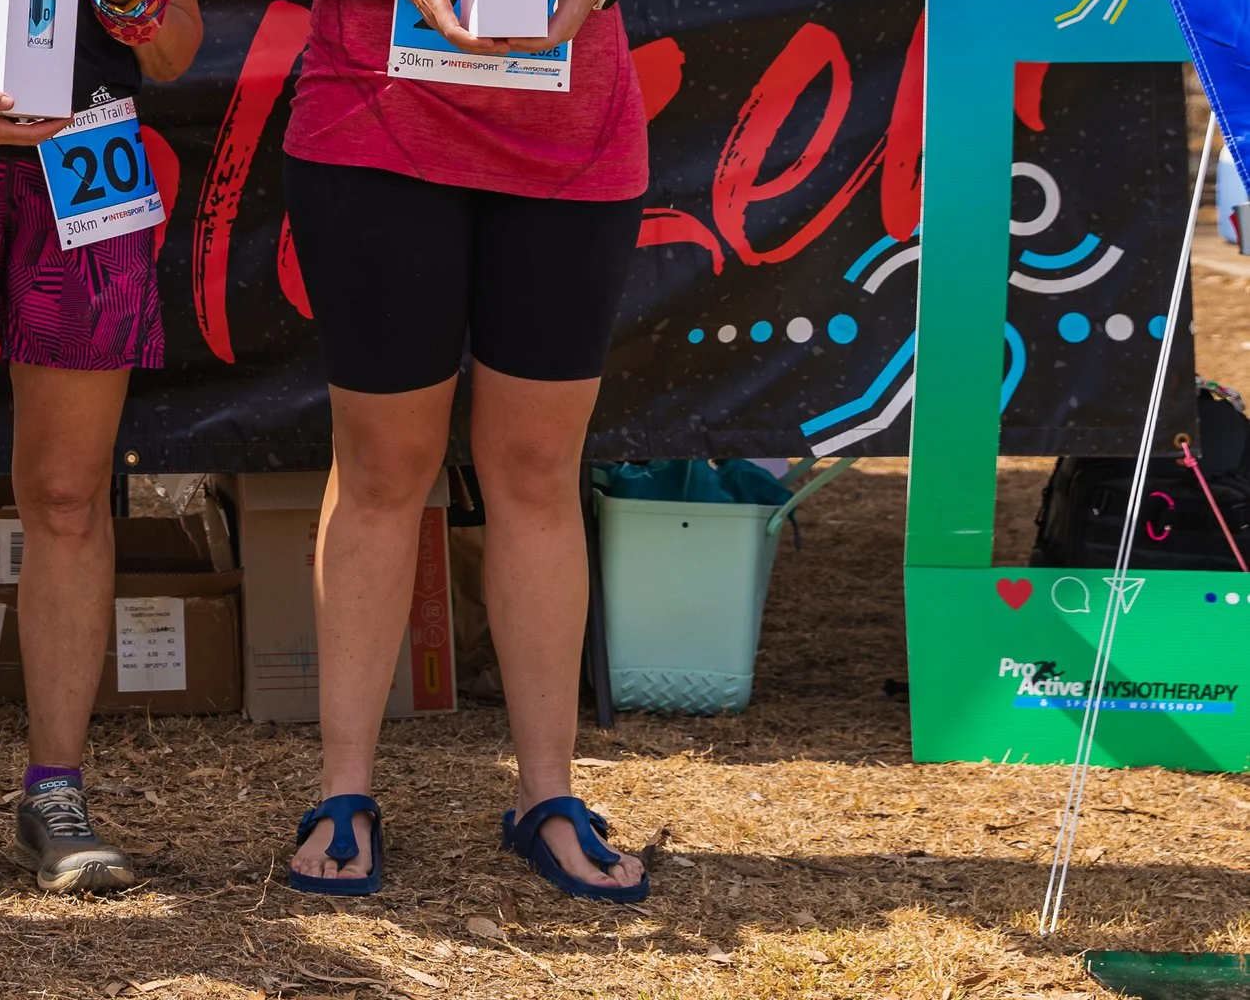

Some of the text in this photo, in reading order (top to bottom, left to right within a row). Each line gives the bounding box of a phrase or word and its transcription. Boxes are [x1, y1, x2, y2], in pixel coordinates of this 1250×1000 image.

[399, 52, 434, 68] 30km
[448, 60, 500, 71] INTERSPORT
[92, 92, 112, 104] CTTR
[100, 103, 124, 120] Trail
[66, 206, 145, 236] 30km INTERSPORT
[998, 657, 1037, 679] Pro
[1016, 676, 1239, 701] Active PHYSIOTHERAPY
[1129, 701, 1204, 712] WORKSHOP
[39, 779, 68, 791] topo
